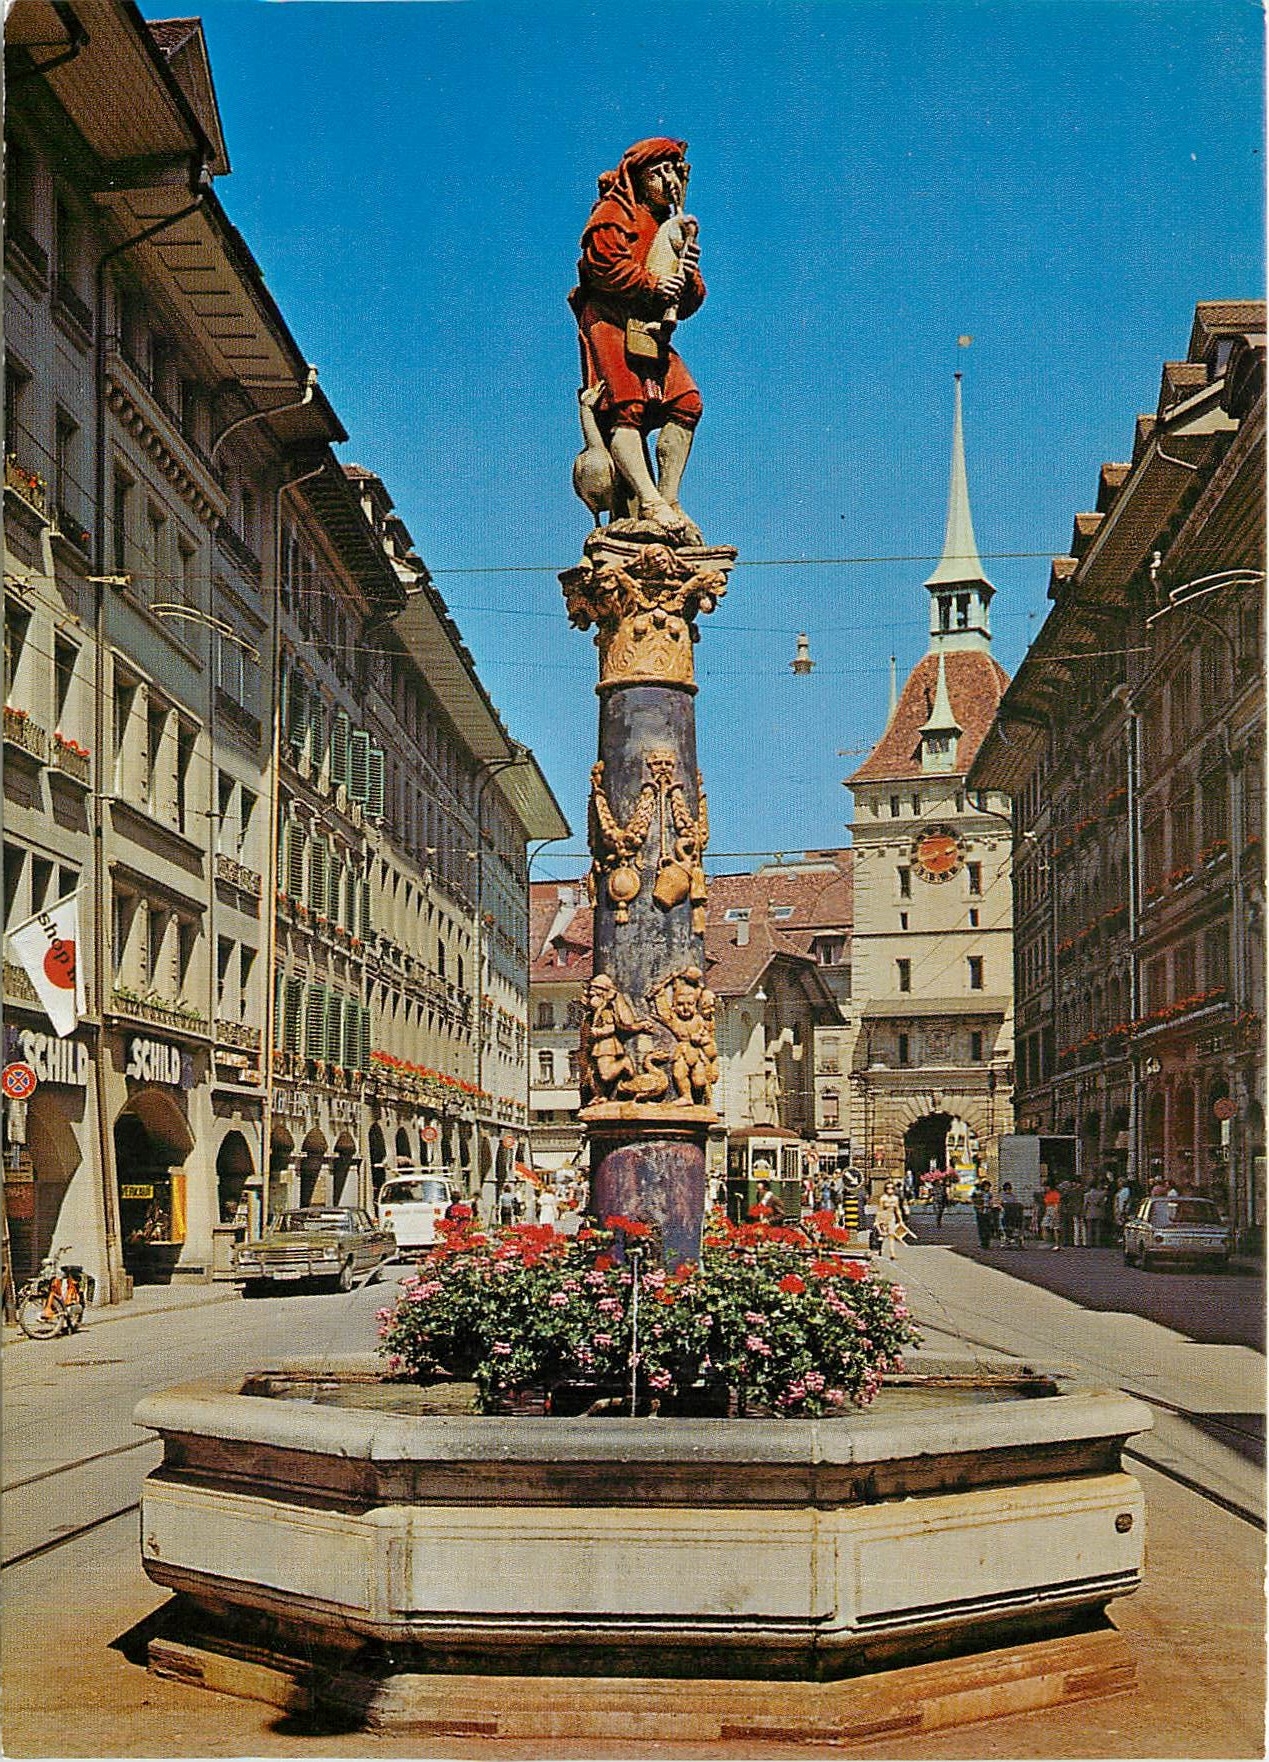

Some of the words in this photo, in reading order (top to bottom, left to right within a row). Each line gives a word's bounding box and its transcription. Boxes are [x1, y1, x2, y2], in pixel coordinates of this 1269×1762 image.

[37, 912, 70, 964] shop
[19, 1029, 90, 1086] SCHILD
[126, 1037, 181, 1085] SCHILD
